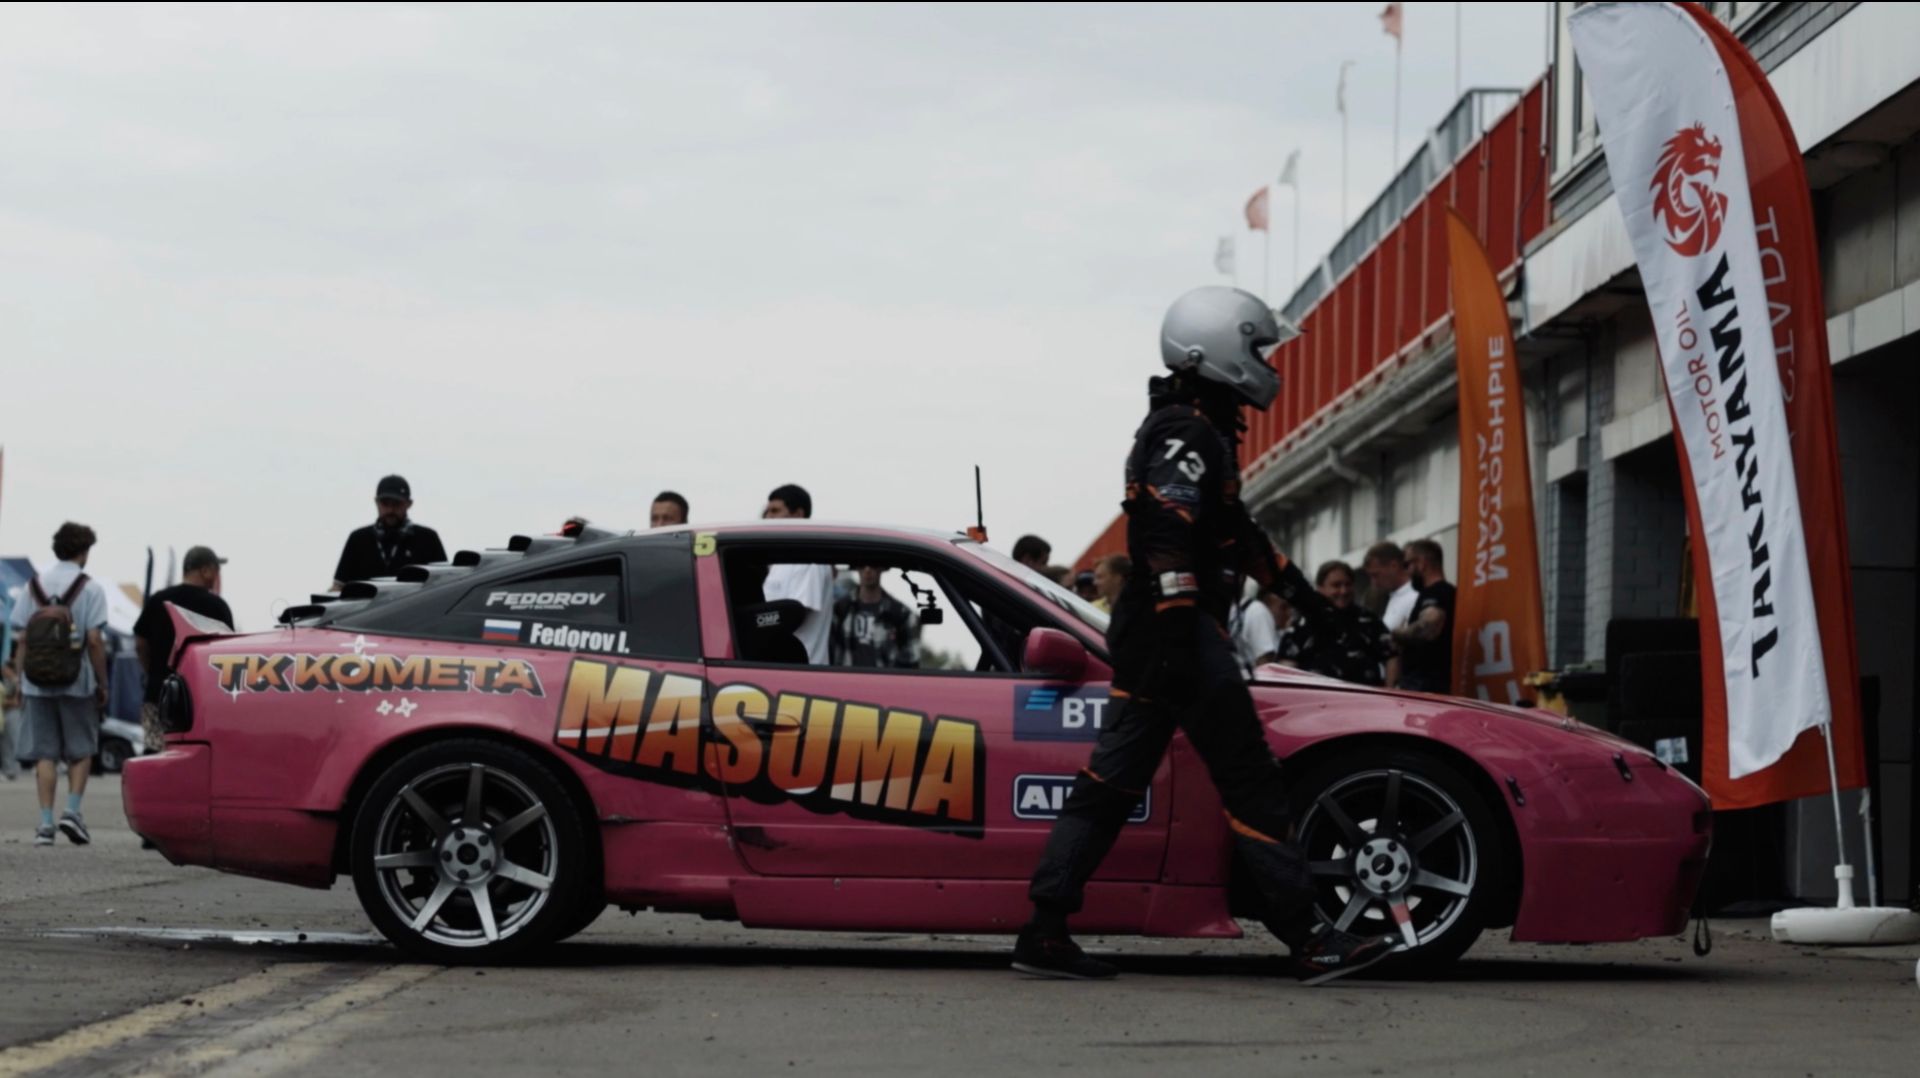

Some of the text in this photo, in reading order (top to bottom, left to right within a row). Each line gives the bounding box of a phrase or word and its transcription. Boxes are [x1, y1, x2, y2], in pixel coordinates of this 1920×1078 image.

[1674, 299, 1727, 461] MOTOR OIL
[1163, 438, 1207, 482] 13
[1695, 251, 1779, 679] TAKAYAMA
[694, 532, 717, 556] 5
[485, 591, 606, 607] FEDOROV
[530, 622, 616, 650] Fedorov
[756, 612, 780, 625] OMP
[556, 657, 980, 828] MASUMA
